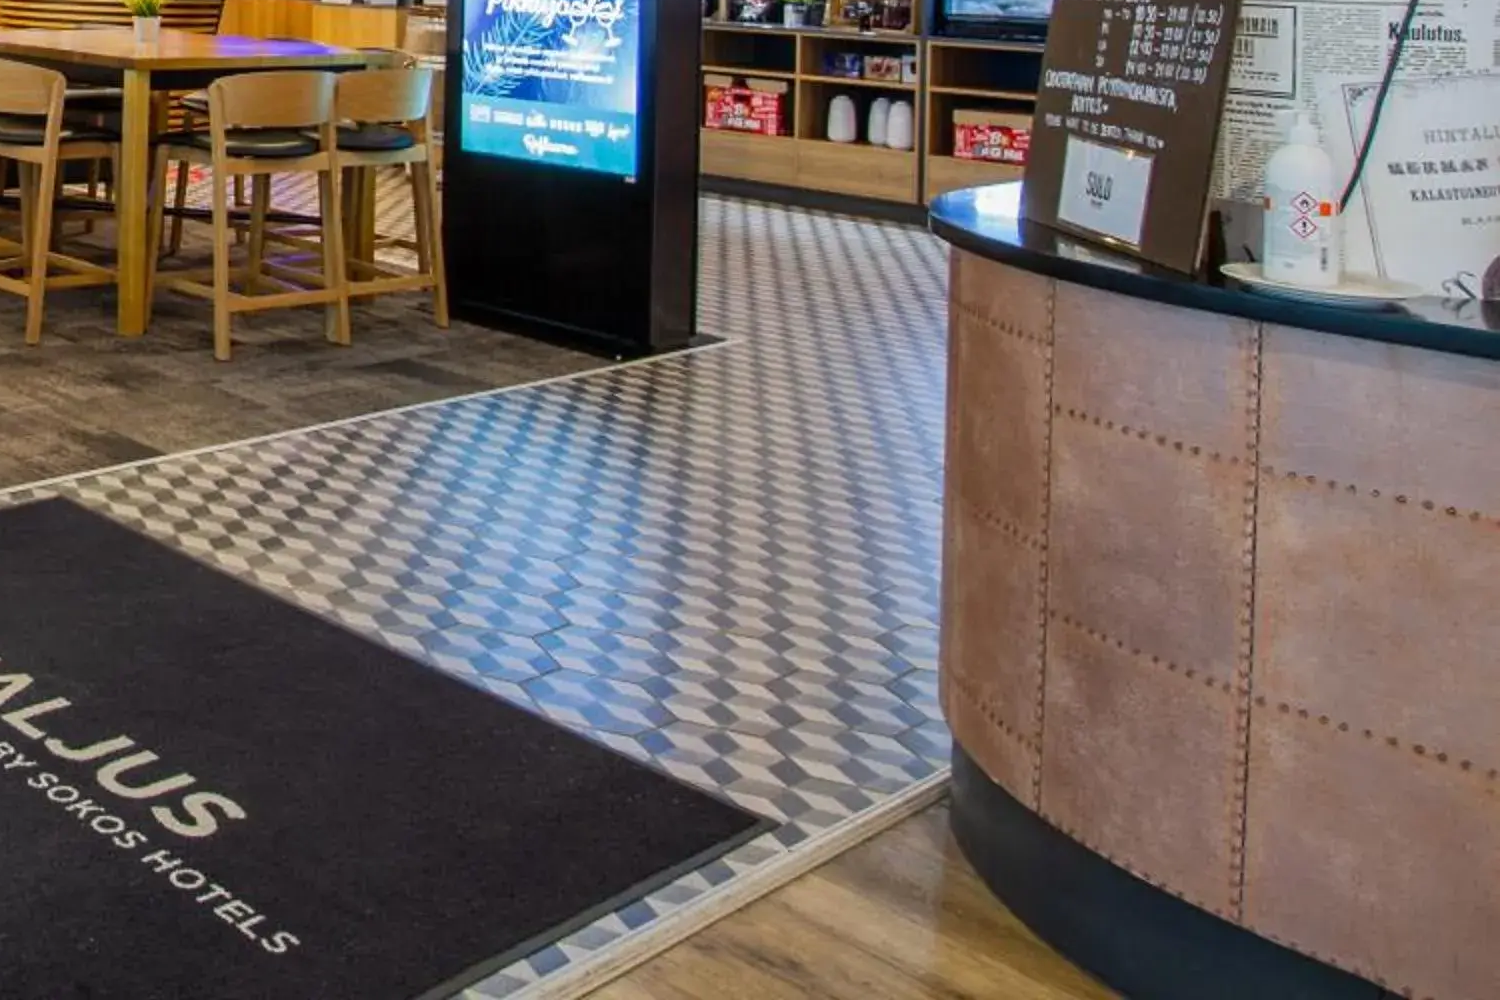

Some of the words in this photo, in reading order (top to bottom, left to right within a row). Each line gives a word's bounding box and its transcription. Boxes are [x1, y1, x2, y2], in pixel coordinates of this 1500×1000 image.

[1388, 22, 1467, 42] Kulutus.
[1086, 171, 1114, 201] SULO
[27, 770, 149, 849] SOKOS
[141, 848, 301, 955] HOTELS
